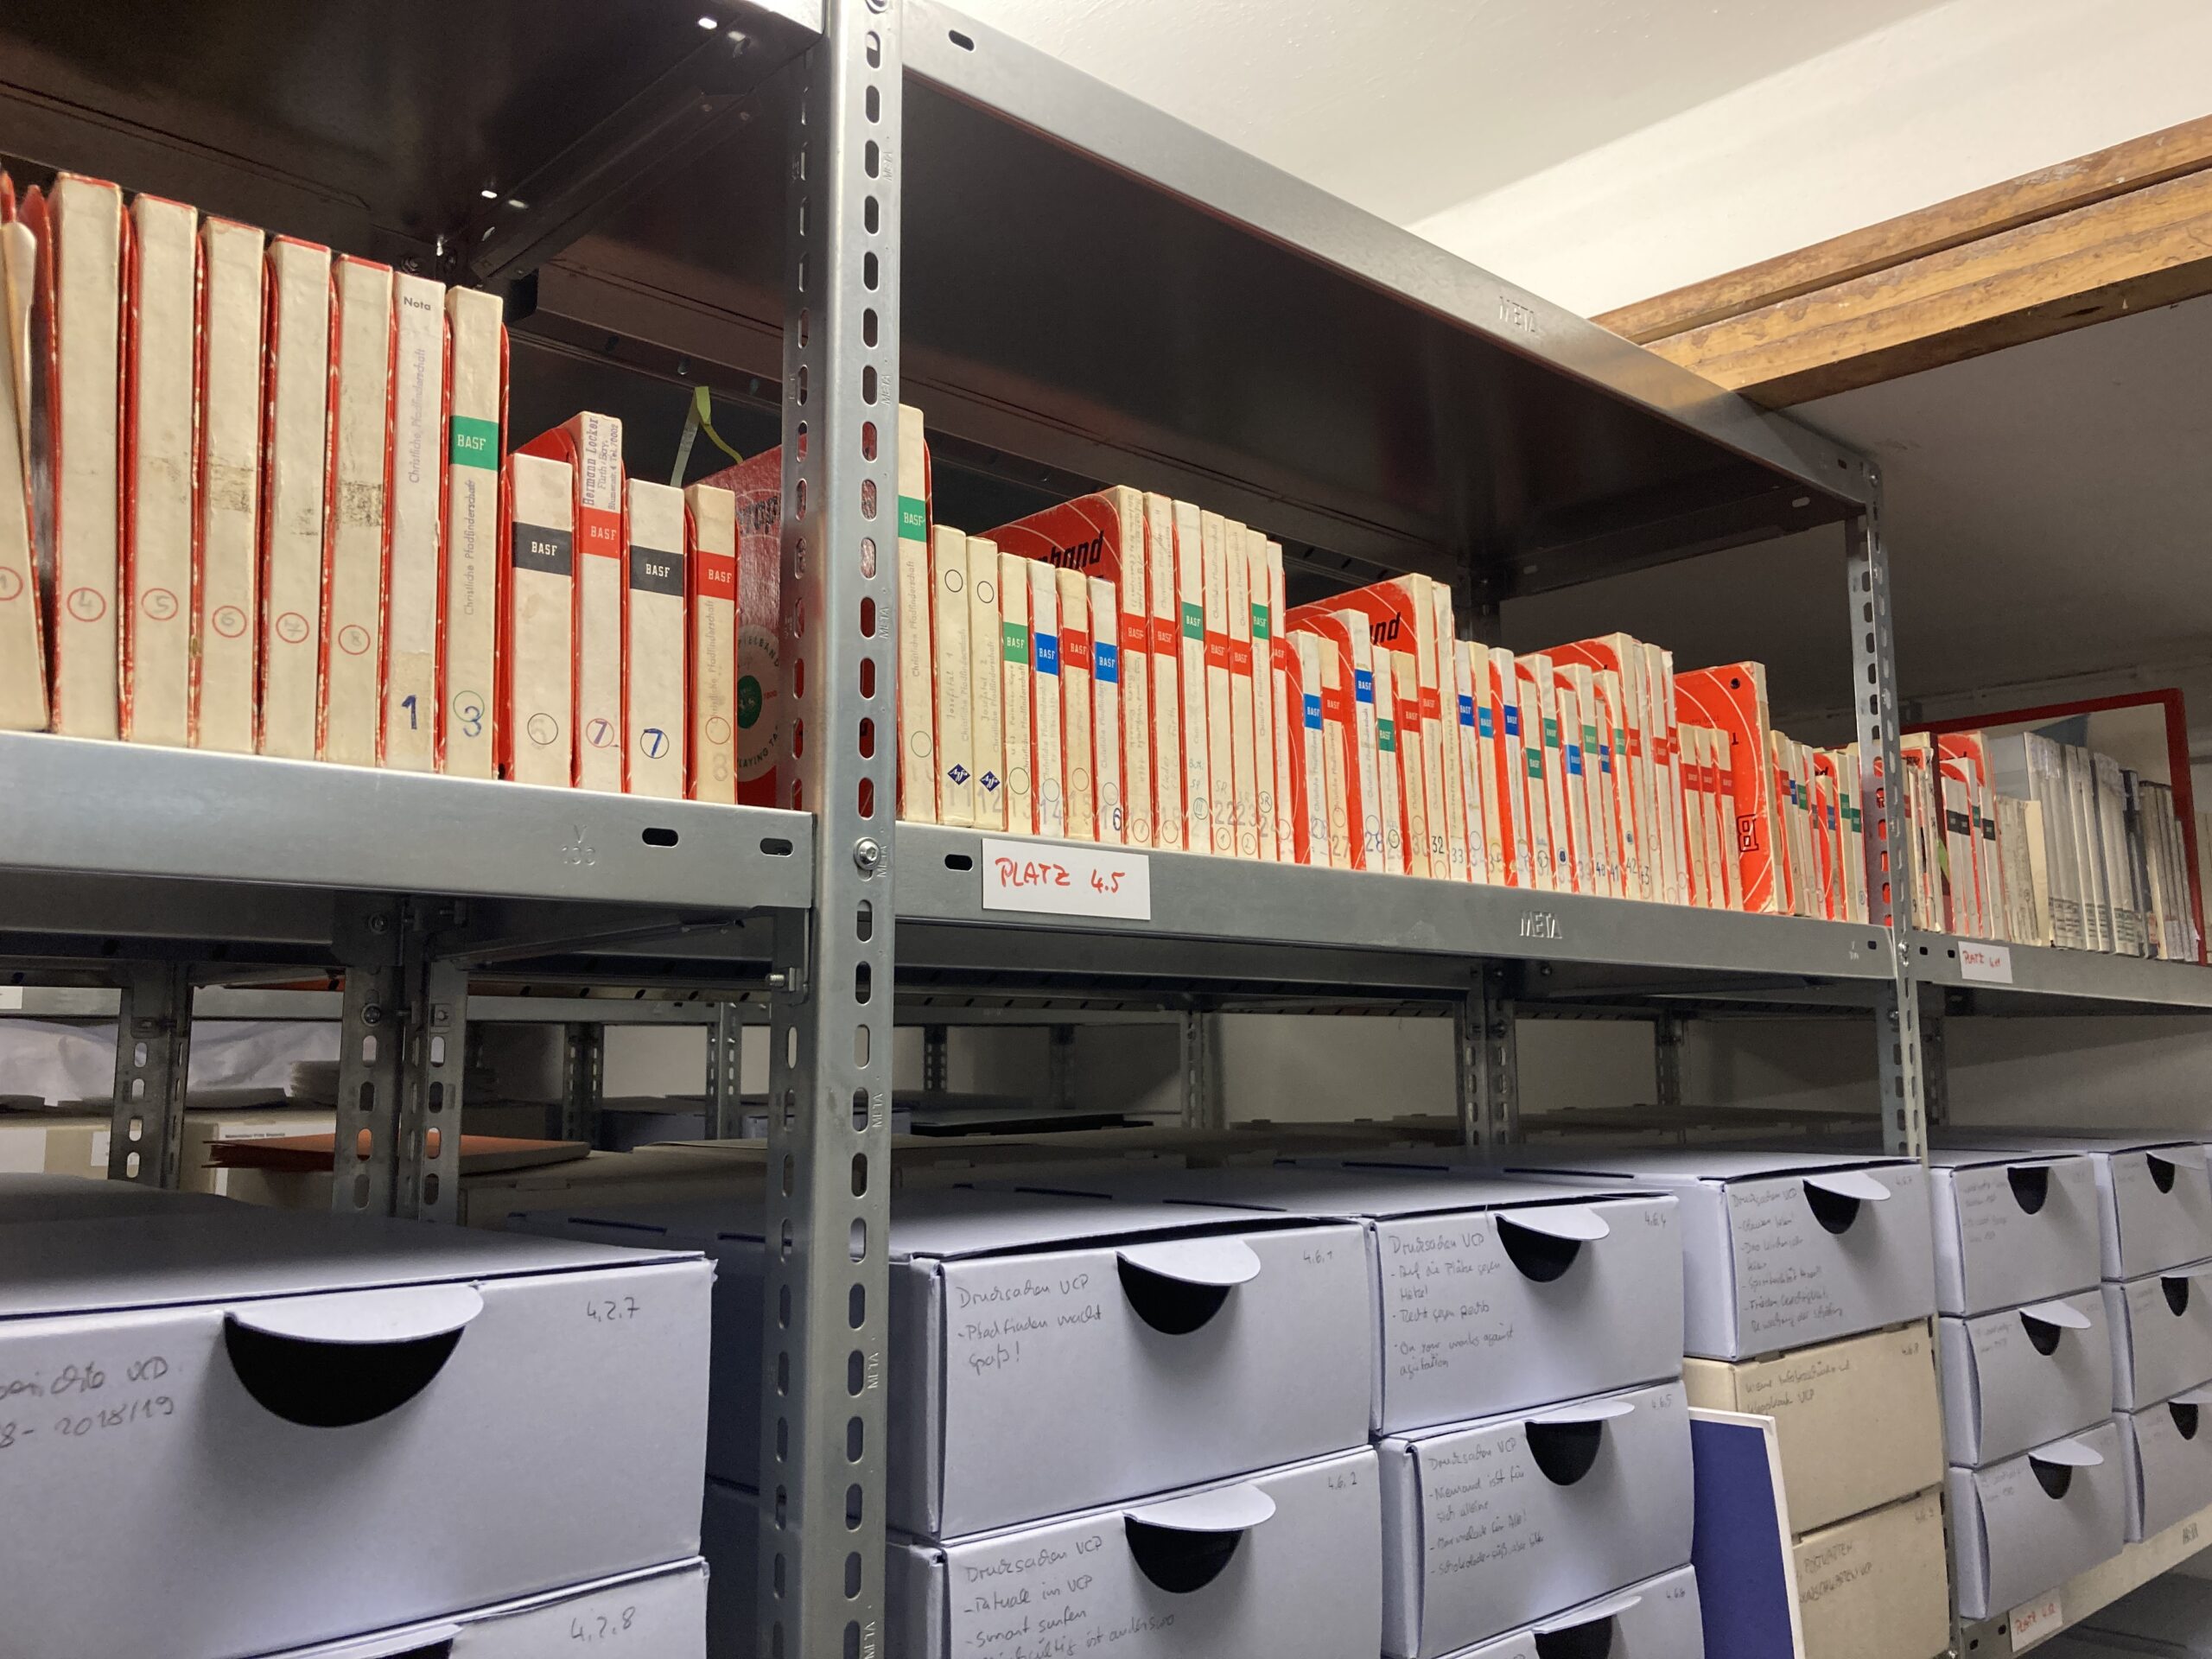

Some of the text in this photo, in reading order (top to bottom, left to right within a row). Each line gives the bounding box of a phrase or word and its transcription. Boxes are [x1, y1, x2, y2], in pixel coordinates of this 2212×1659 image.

[404, 296, 431, 311] Nota
[457, 434, 486, 450] BASF
[409, 434, 423, 483] Christliche
[582, 417, 598, 506] Hermann Locker
[904, 512, 923, 526] BASF
[590, 525, 616, 541] BASF
[464, 480, 476, 616] Christliche Pfadfinderschaft
[531, 541, 557, 556] BASF
[645, 563, 671, 578] BASF
[708, 569, 732, 583] BASF
[153, 594, 170, 616] 5
[906, 560, 921, 677] Christliche Pfadfinderschaft
[1186, 614, 1200, 627] BASF
[1253, 615, 1267, 628] BASF
[706, 600, 716, 672] Pfadfinderschaft
[1128, 626, 1144, 639] BASF
[1158, 631, 1173, 643] BASF
[1007, 638, 1025, 649] BASF
[1071, 643, 1086, 655] BASF
[1211, 644, 1225, 656] BASF
[1039, 647, 1055, 660] BASF
[1235, 652, 1248, 664] BASF
[1099, 656, 1116, 668] BASF
[1358, 680, 1372, 690] BASF
[1327, 698, 1340, 709] BASF
[401, 693, 417, 731] 1
[1306, 706, 1320, 717] BASF
[463, 705, 481, 739] 3
[594, 720, 607, 746] 7
[643, 728, 664, 759] 7
[1432, 836, 1444, 855] 32
[1452, 848, 1464, 864] 33
[995, 857, 1125, 893] PLATZ 4.5
[1389, 1230, 1484, 1254] Drucksachen VCP
[955, 1274, 1089, 1308] Drucksachen VCP
[1497, 1438, 1516, 1452] VCP
[966, 1536, 1103, 1583] Drucksachen VCP
[1067, 1574, 1094, 1593] VCP
